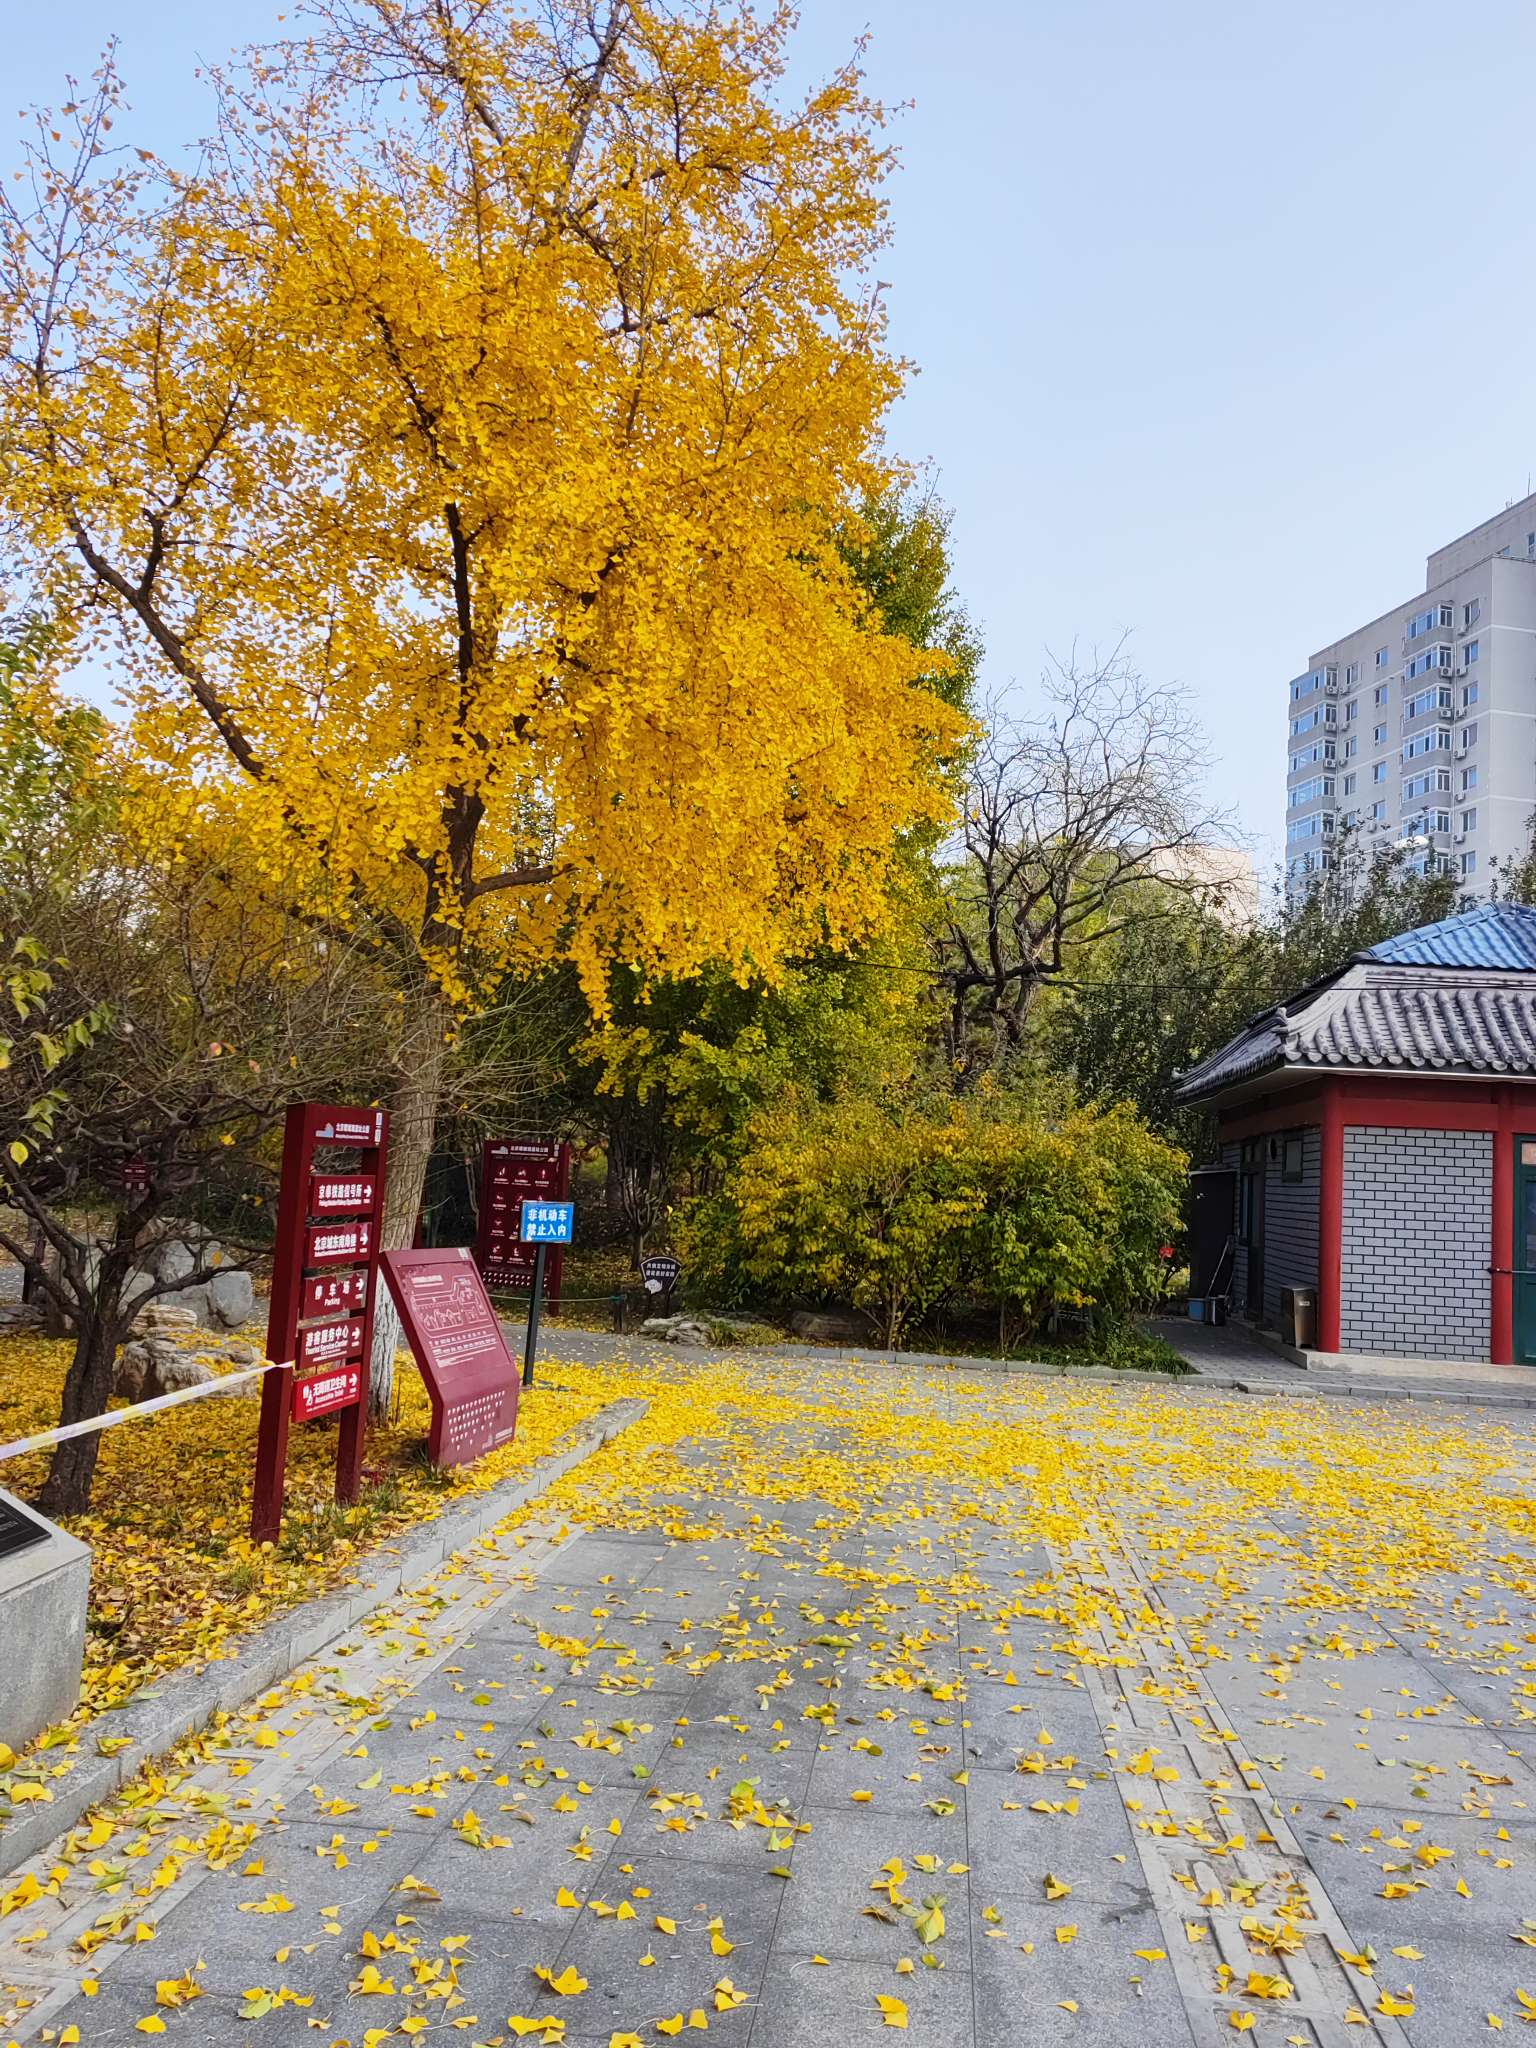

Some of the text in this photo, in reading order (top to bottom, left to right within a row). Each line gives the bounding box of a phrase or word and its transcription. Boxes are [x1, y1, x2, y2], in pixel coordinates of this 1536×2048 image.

[527, 1208, 568, 1222] 非机动车
[526, 1223, 567, 1237] 禁止入内
